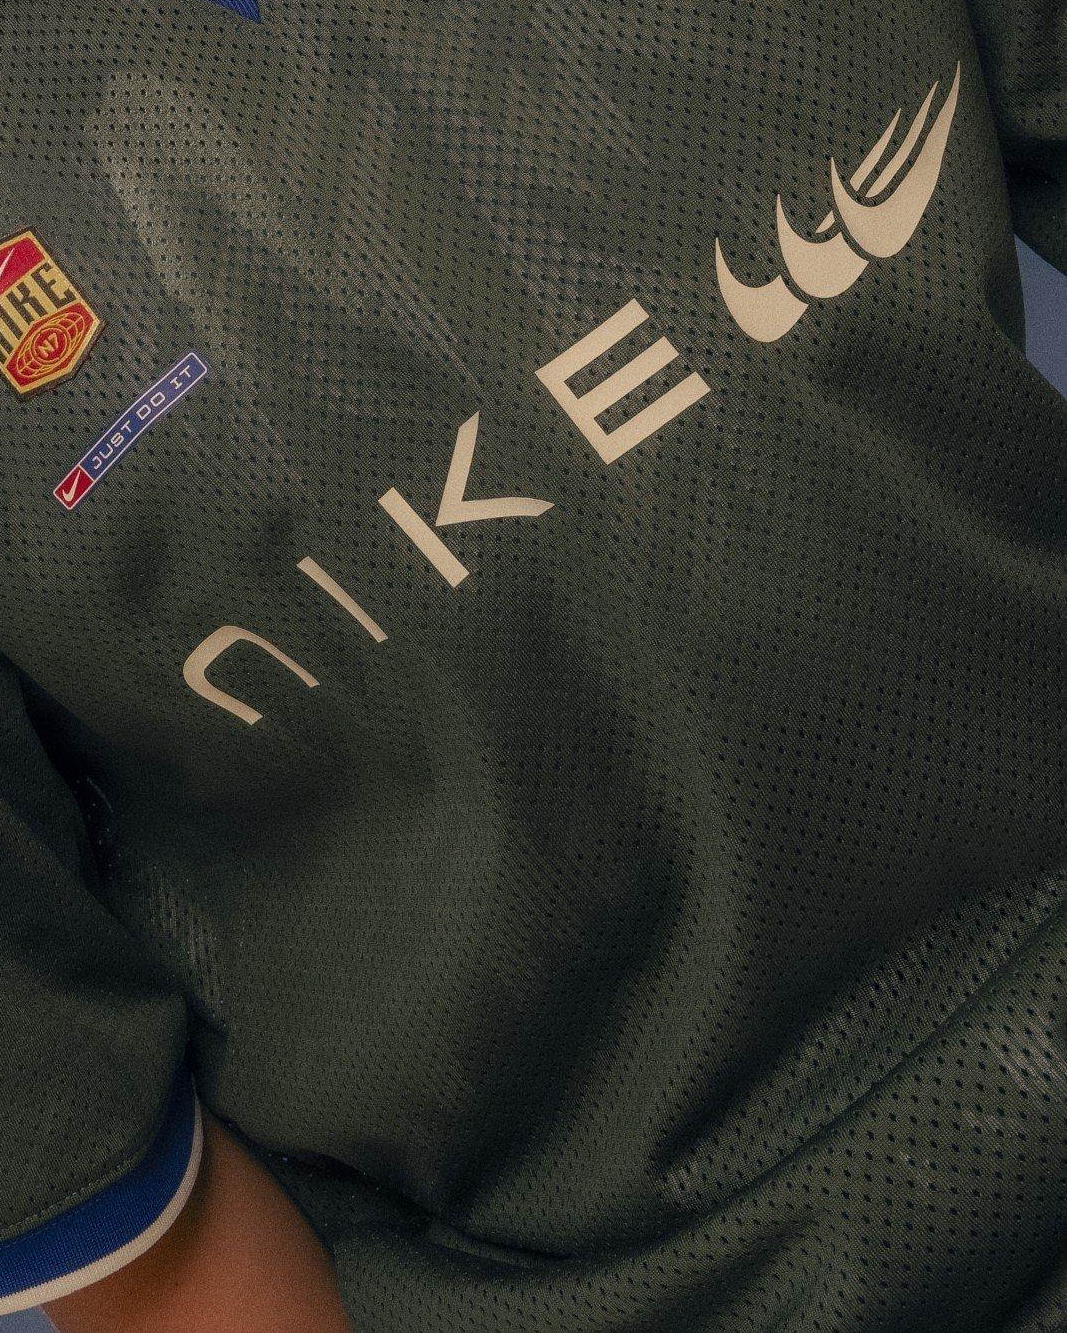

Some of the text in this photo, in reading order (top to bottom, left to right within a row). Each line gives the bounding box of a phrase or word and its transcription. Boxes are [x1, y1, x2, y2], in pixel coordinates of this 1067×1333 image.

[92, 364, 192, 470] JUST DO IT
